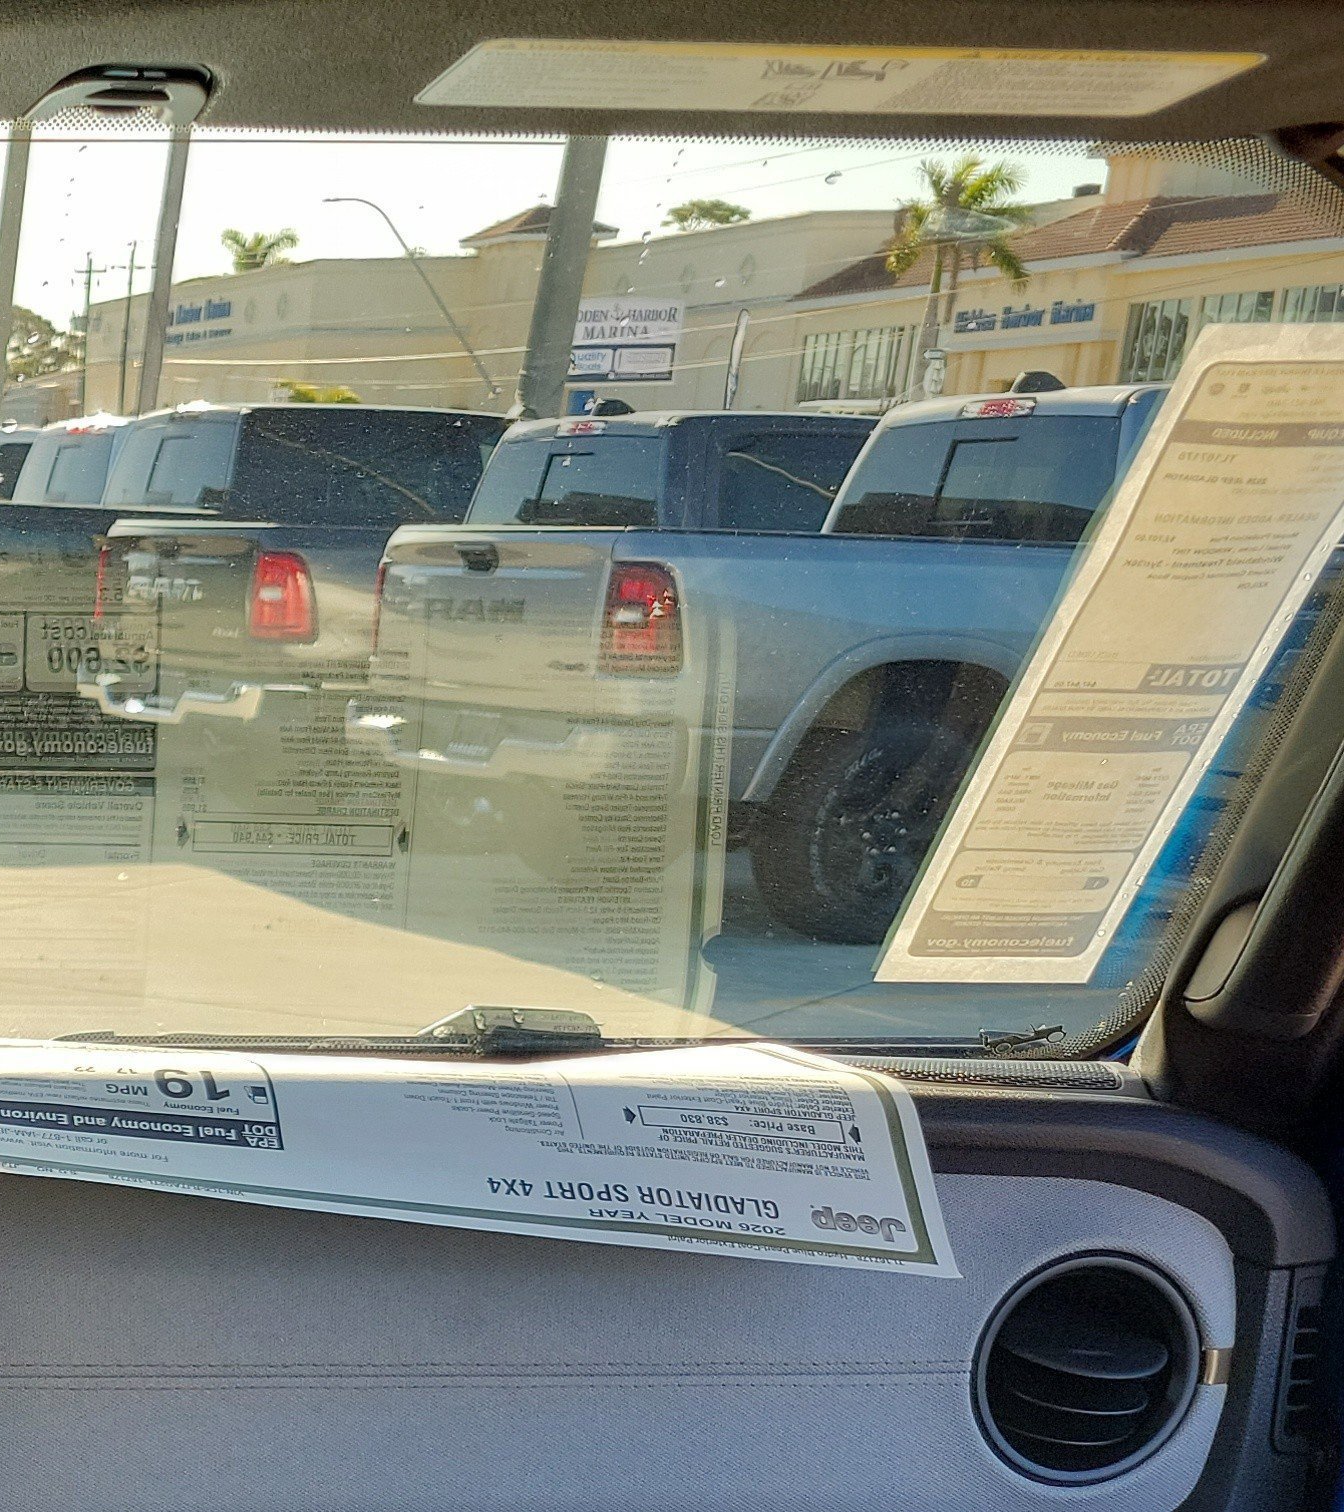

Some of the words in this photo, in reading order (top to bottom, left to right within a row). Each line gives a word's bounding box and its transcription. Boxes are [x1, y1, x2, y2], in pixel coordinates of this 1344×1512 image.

[628, 307, 678, 323] HARBOR
[583, 325, 649, 340] MARINA
[105, 1083, 149, 1097] MPG
[153, 1068, 231, 1102] 19
[163, 1100, 214, 1114] Economy
[216, 1106, 240, 1116] Fuel
[72, 1114, 107, 1129] and
[112, 1115, 194, 1138] Economy
[749, 1119, 784, 1132] Price:
[198, 1124, 237, 1140] Fuel
[243, 1124, 277, 1137] DOT
[788, 1123, 816, 1135] Base
[245, 1136, 278, 1149] EPA
[150, 1154, 169, 1163] For
[487, 1177, 533, 1197] 4X4
[543, 1181, 629, 1202] SPORT
[636, 1185, 779, 1220] GLADIATOR
[588, 1208, 649, 1221] YEAR
[654, 1212, 732, 1232] MODEL
[738, 1222, 786, 1236] 2026
